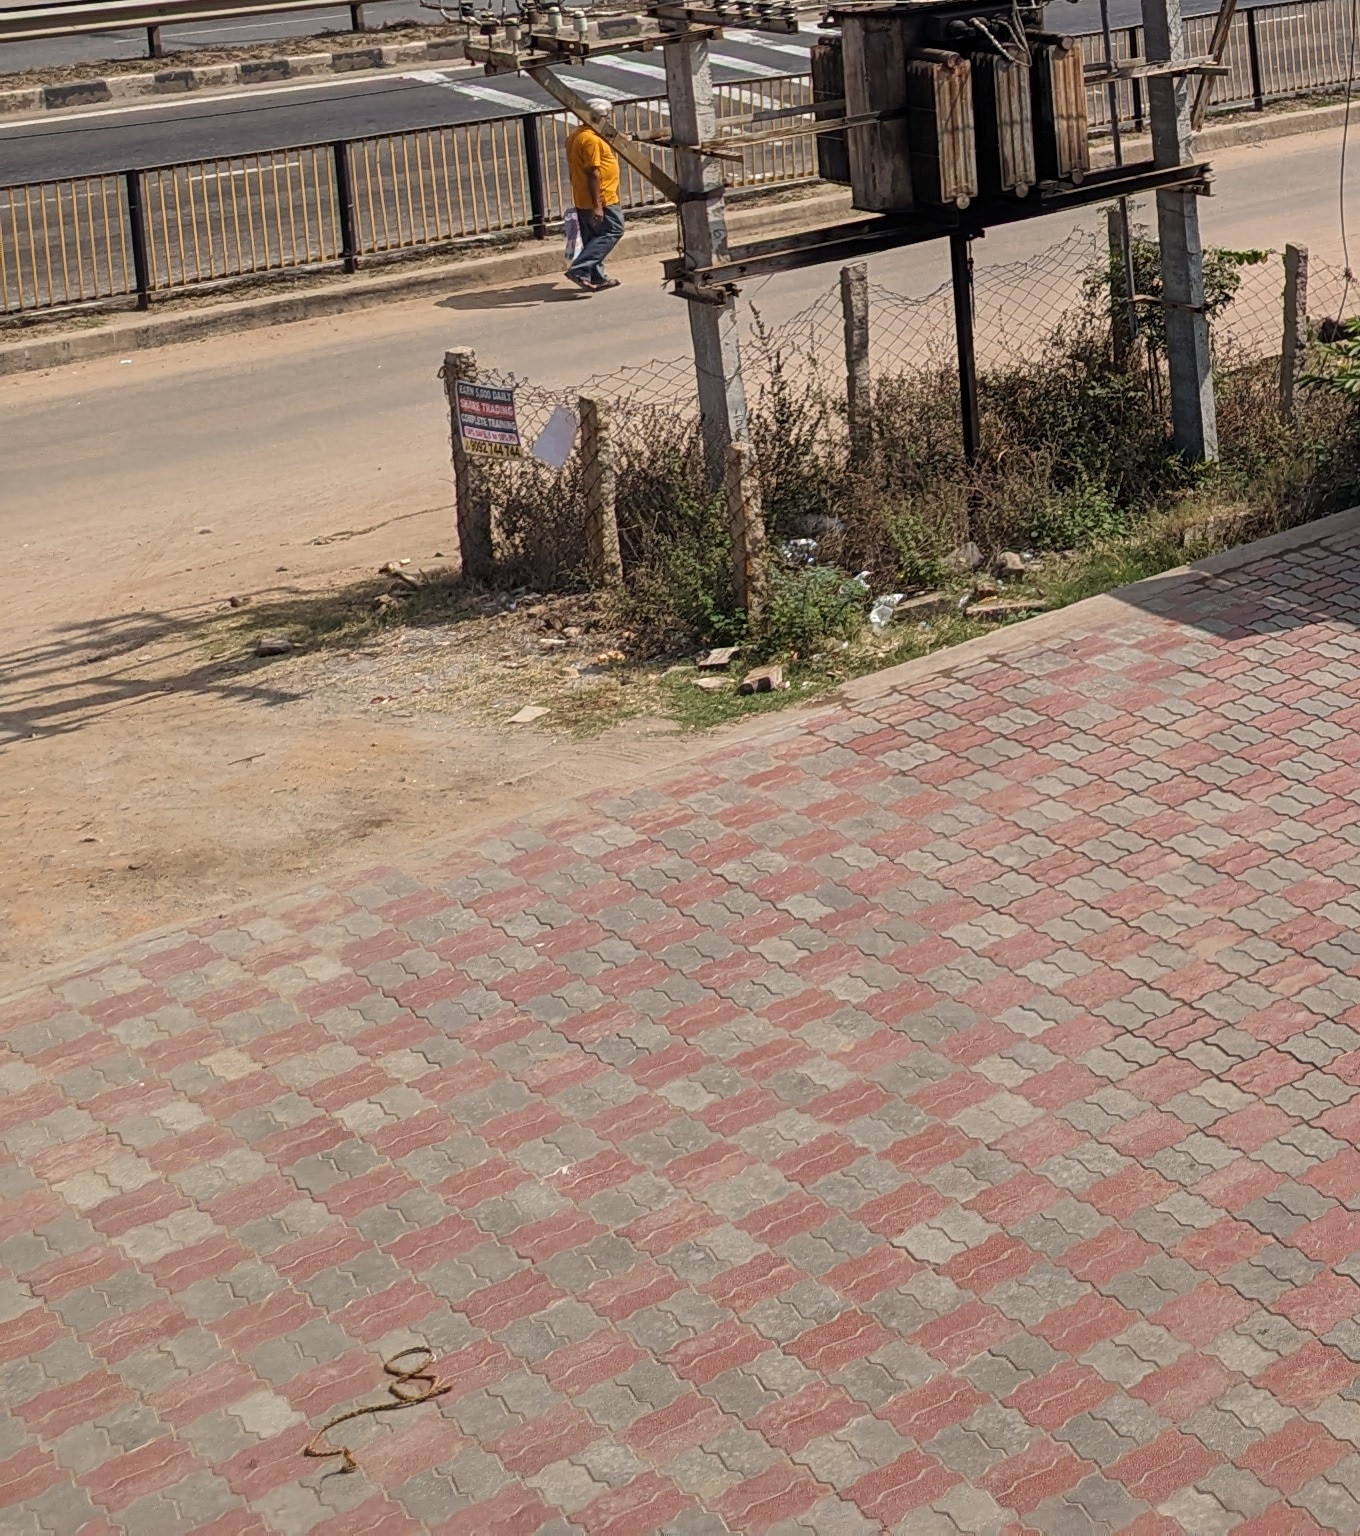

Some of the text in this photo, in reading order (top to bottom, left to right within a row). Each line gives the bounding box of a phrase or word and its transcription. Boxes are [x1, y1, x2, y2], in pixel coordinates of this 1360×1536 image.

[459, 384, 475, 396] EARN
[492, 390, 512, 402] DAILY
[481, 402, 514, 416] TRADING
[461, 413, 488, 426] COMPLETE
